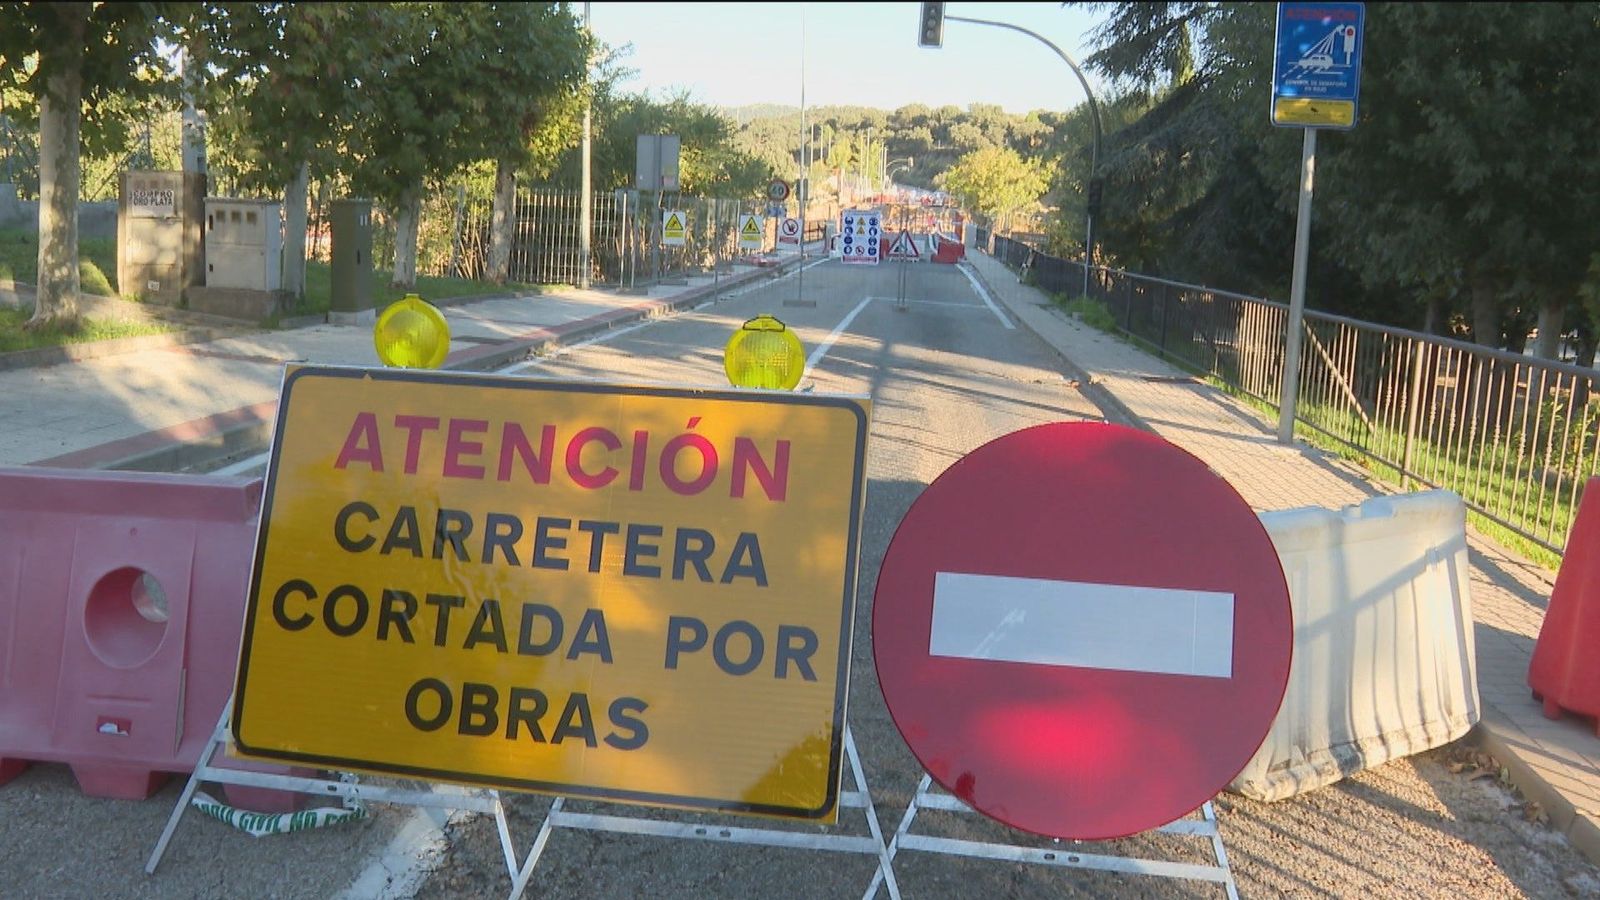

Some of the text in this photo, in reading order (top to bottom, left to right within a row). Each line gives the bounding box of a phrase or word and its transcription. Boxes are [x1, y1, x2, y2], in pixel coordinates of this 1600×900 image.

[133, 190, 172, 198] COMPRO
[133, 197, 173, 206] ORO PLATA
[334, 412, 791, 502] ATENCIÓN
[334, 501, 768, 587] CARRETERA
[272, 579, 819, 682] CORTADA POR
[404, 678, 650, 751] OBRAS
